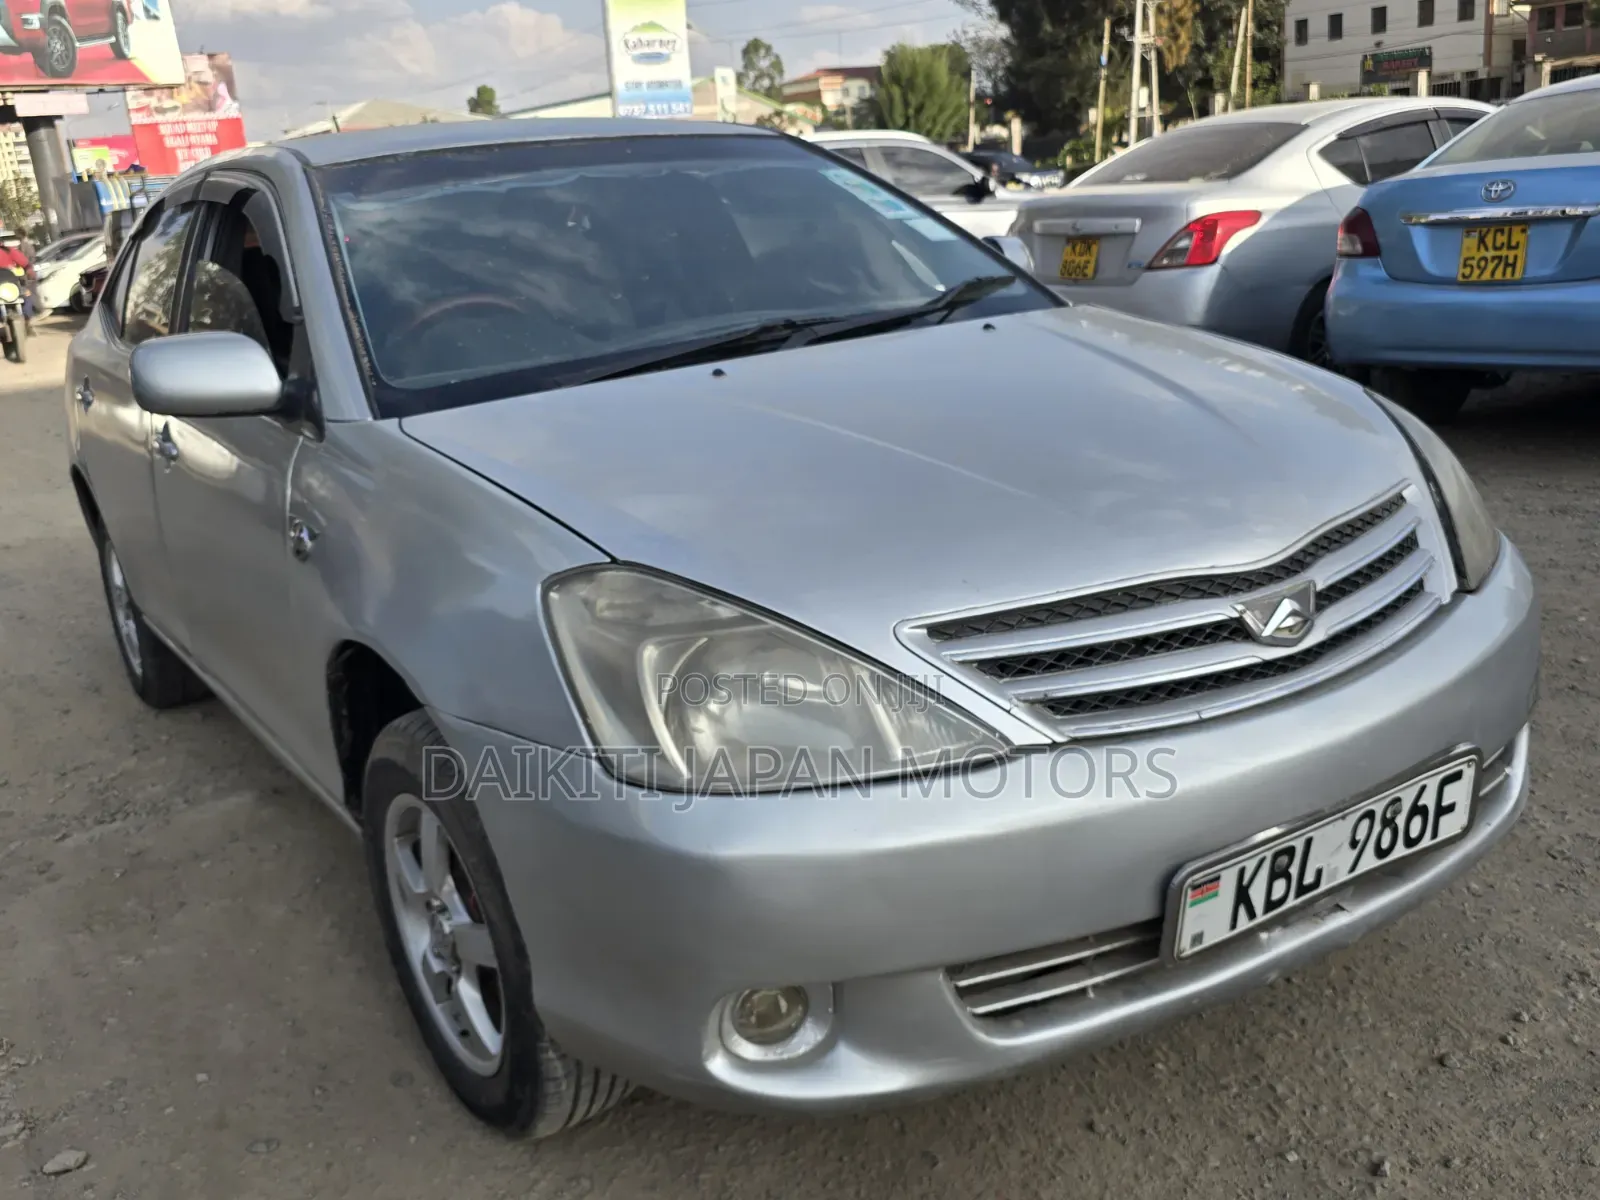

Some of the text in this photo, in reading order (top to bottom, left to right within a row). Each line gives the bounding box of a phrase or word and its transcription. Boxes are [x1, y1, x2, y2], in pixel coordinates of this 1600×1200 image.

[1477, 227, 1520, 252] KCL
[1461, 255, 1518, 279] 597H
[1229, 768, 1464, 930] KBL 986F
